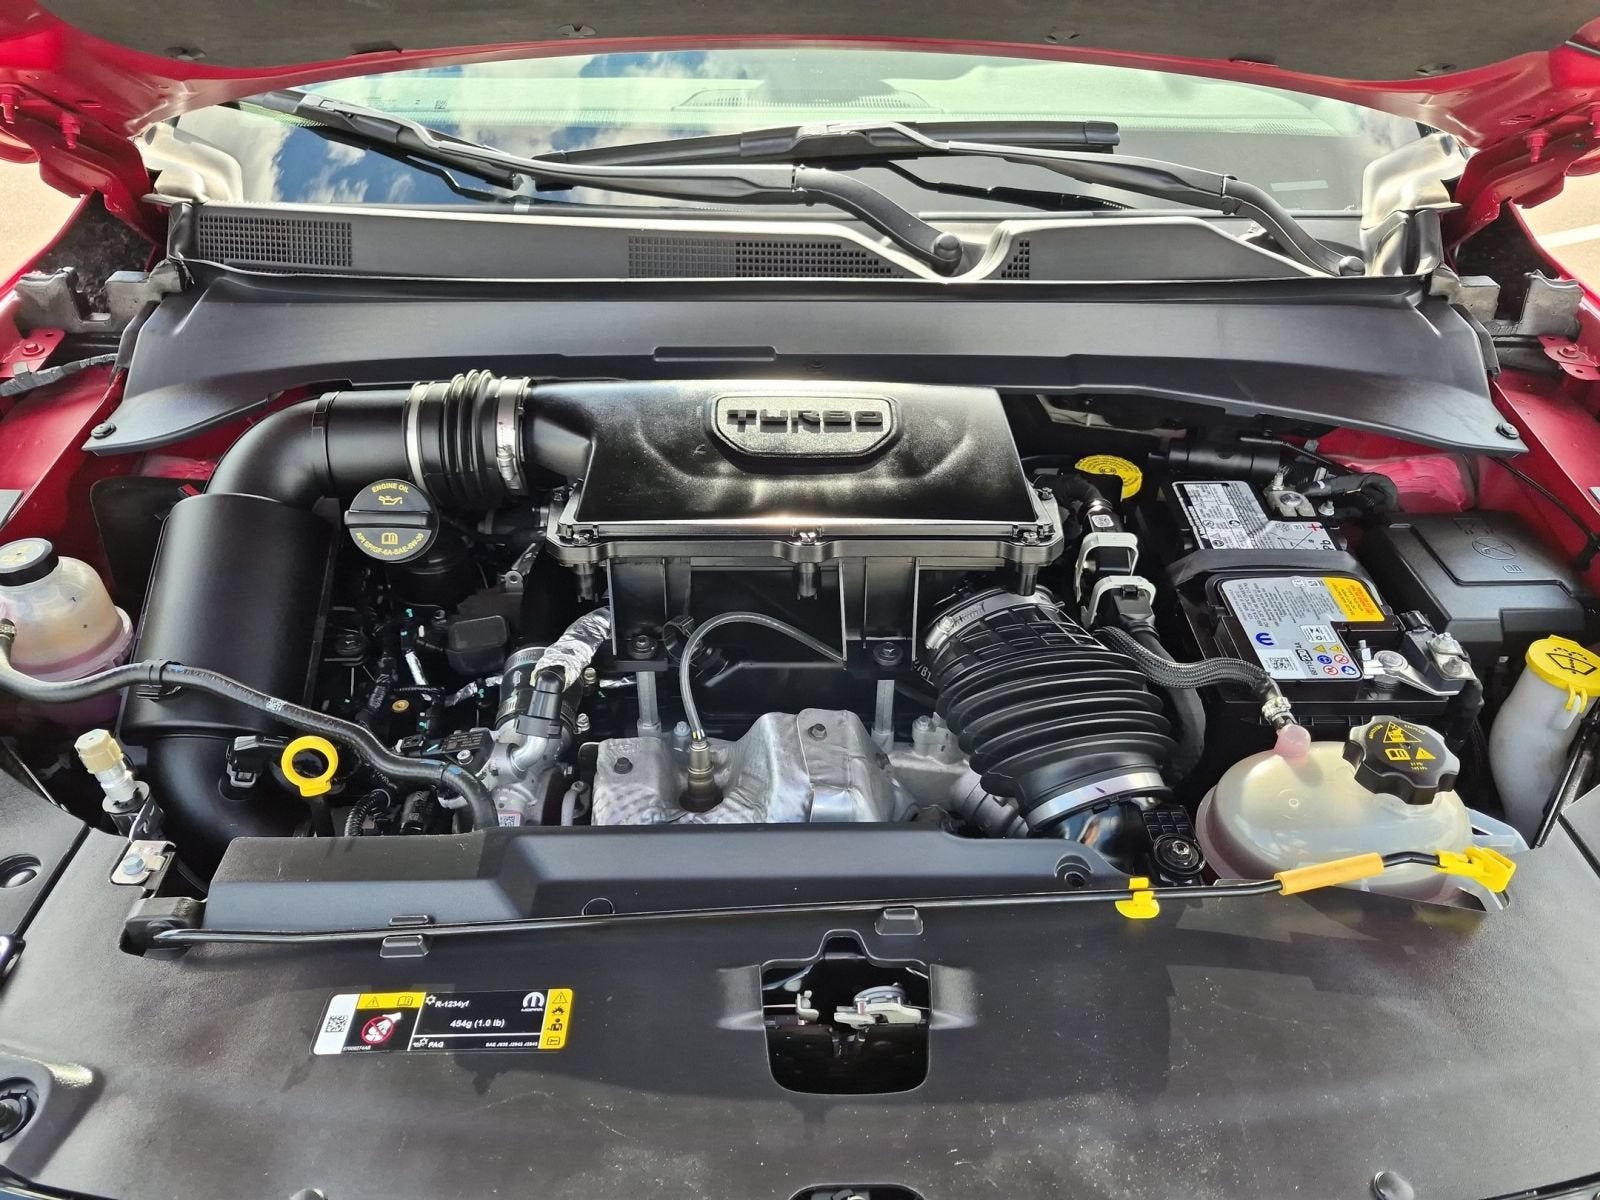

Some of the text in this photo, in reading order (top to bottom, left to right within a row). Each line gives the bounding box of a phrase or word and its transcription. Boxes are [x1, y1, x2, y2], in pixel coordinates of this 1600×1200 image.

[727, 409, 883, 433] TURBO
[372, 483, 408, 493] ENGINE OIL
[435, 1000, 470, 1008] R-1234yf
[450, 1018, 505, 1029] 454g (1.0 lb)
